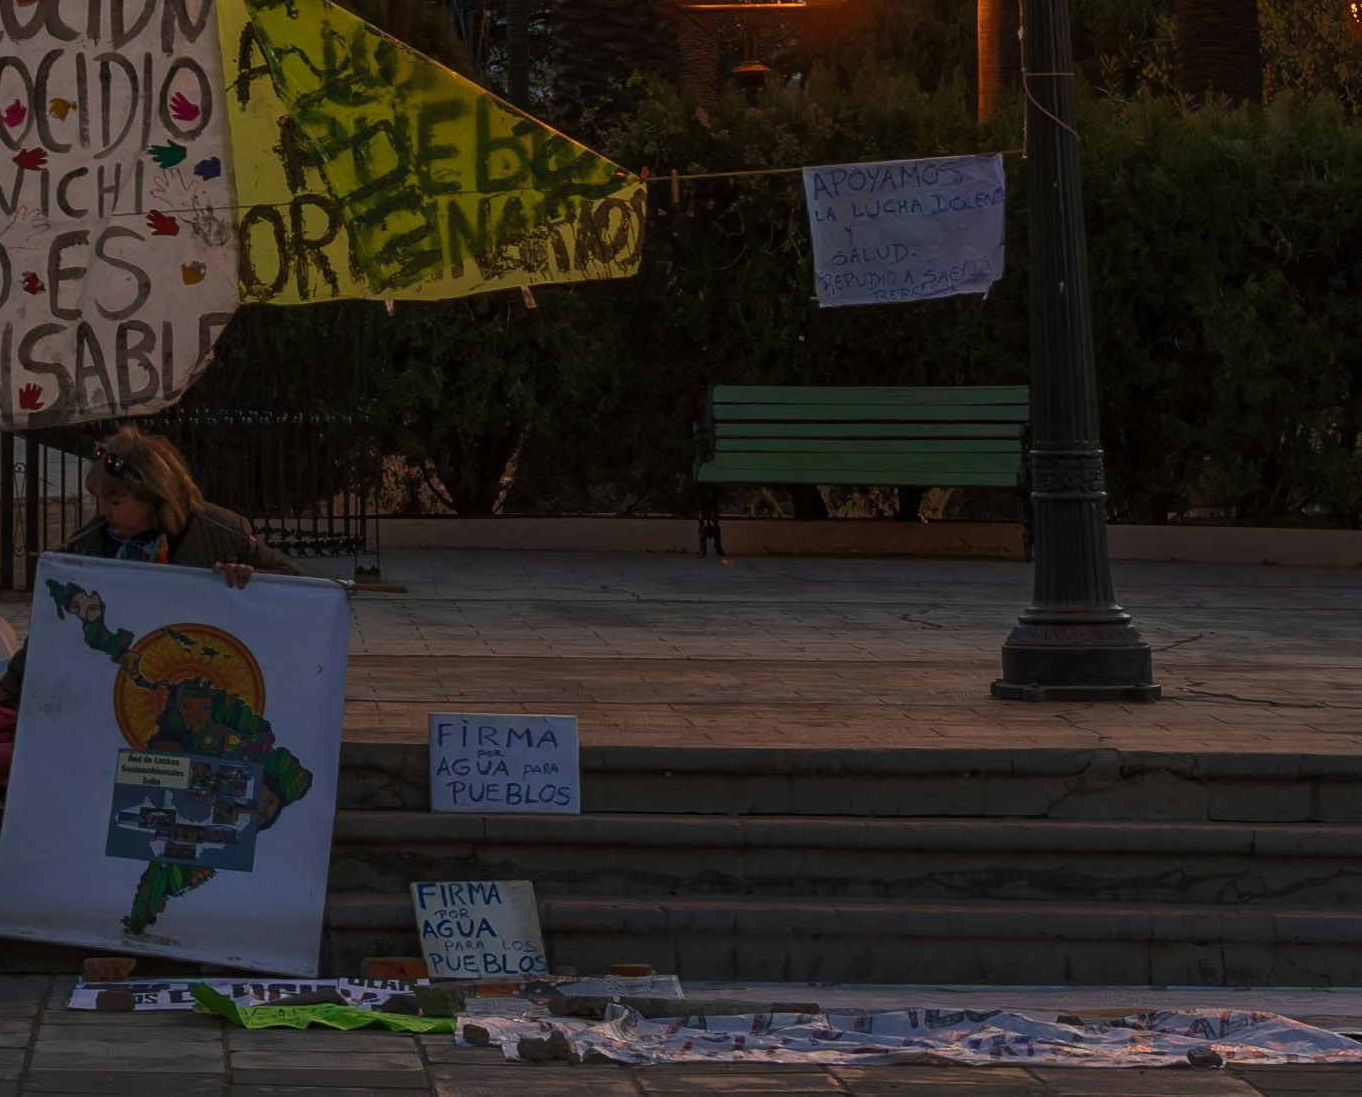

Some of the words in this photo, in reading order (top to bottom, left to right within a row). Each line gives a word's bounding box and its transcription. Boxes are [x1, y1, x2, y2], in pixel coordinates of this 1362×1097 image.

[813, 162, 964, 200] APOYAMOS
[815, 209, 837, 223] LA
[853, 200, 923, 218] LUCHA
[48, 229, 152, 322] ES
[436, 757, 510, 778] AGUA
[523, 762, 560, 781] PARA
[445, 781, 572, 807] PUEBLOS
[416, 882, 503, 911] FIRMA
[433, 907, 471, 920] POR
[422, 917, 498, 939] AGUA
[444, 939, 486, 953] PARA
[501, 938, 536, 953] LOS
[427, 952, 548, 975] PUEBLOS
